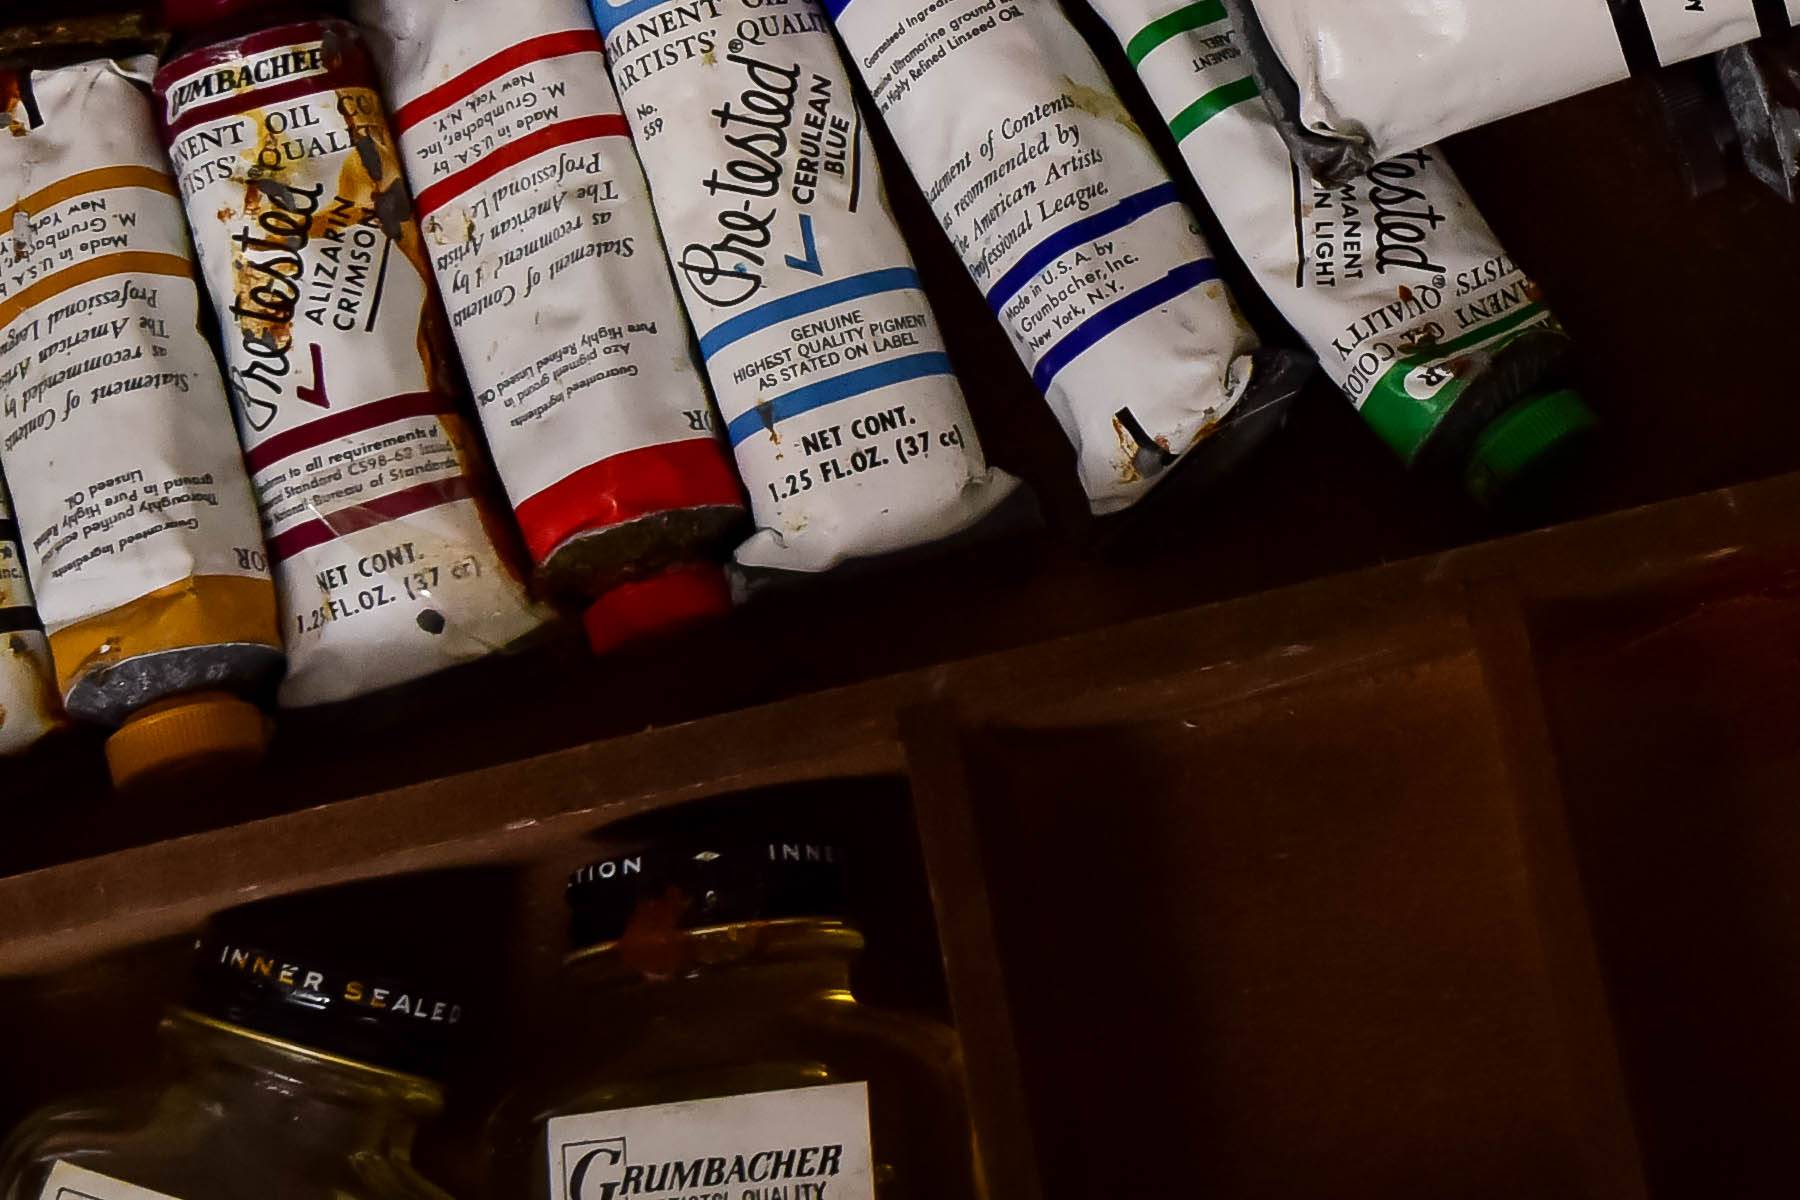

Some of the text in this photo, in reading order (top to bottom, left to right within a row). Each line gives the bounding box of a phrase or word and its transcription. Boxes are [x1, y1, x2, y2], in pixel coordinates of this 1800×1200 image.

[890, 27, 946, 75] Ultramarine
[908, 16, 997, 82] Refined Linseed
[502, 72, 534, 92] New
[637, 103, 658, 120] No.
[265, 105, 320, 134] OIL
[433, 106, 558, 175] Made in by
[444, 82, 565, 145] M. Grumbacher,
[643, 118, 664, 141] 559
[792, 74, 833, 205] CERULEAN
[980, 93, 1075, 161] of Contents
[824, 115, 849, 180] BLUE
[953, 123, 1080, 217] recommended by
[68, 198, 106, 215] New
[491, 180, 619, 240] The American
[493, 153, 601, 212] Professional
[972, 149, 1103, 242] American Artists
[59, 234, 128, 260] Made in
[305, 195, 356, 326] ALIZARIN
[968, 181, 1109, 283] Professional League.
[1315, 222, 1335, 287] LIGHT
[48, 280, 159, 334] Professional
[454, 237, 634, 327] Statement of Contents
[1005, 241, 1113, 321] Made in by
[1021, 253, 1139, 332] Grumbacher, Inc.
[39, 316, 170, 363] The American
[536, 326, 623, 373] Highly Refined
[733, 314, 928, 384] HIGHEST QUALITY PIGMENT
[791, 310, 864, 341] GENUINE
[1028, 304, 1086, 352] New York,
[1332, 285, 1441, 360] QUALITY
[23, 345, 142, 412] recommended
[567, 365, 639, 400] Guaranteed
[759, 332, 918, 391] AS STATED ON LABEL
[62, 373, 189, 422] Statement of
[305, 456, 323, 473] all
[328, 427, 426, 465] requirements
[802, 406, 916, 456] NET CONT.
[89, 469, 144, 498] Linseed
[769, 424, 966, 503] 1.25 FL.OZ. (37 cc)
[316, 543, 424, 592] NET CONT.
[568, 857, 642, 884] TION
[221, 946, 463, 1023] INNER SEALED
[569, 1143, 843, 1200] GRUMBACHER
